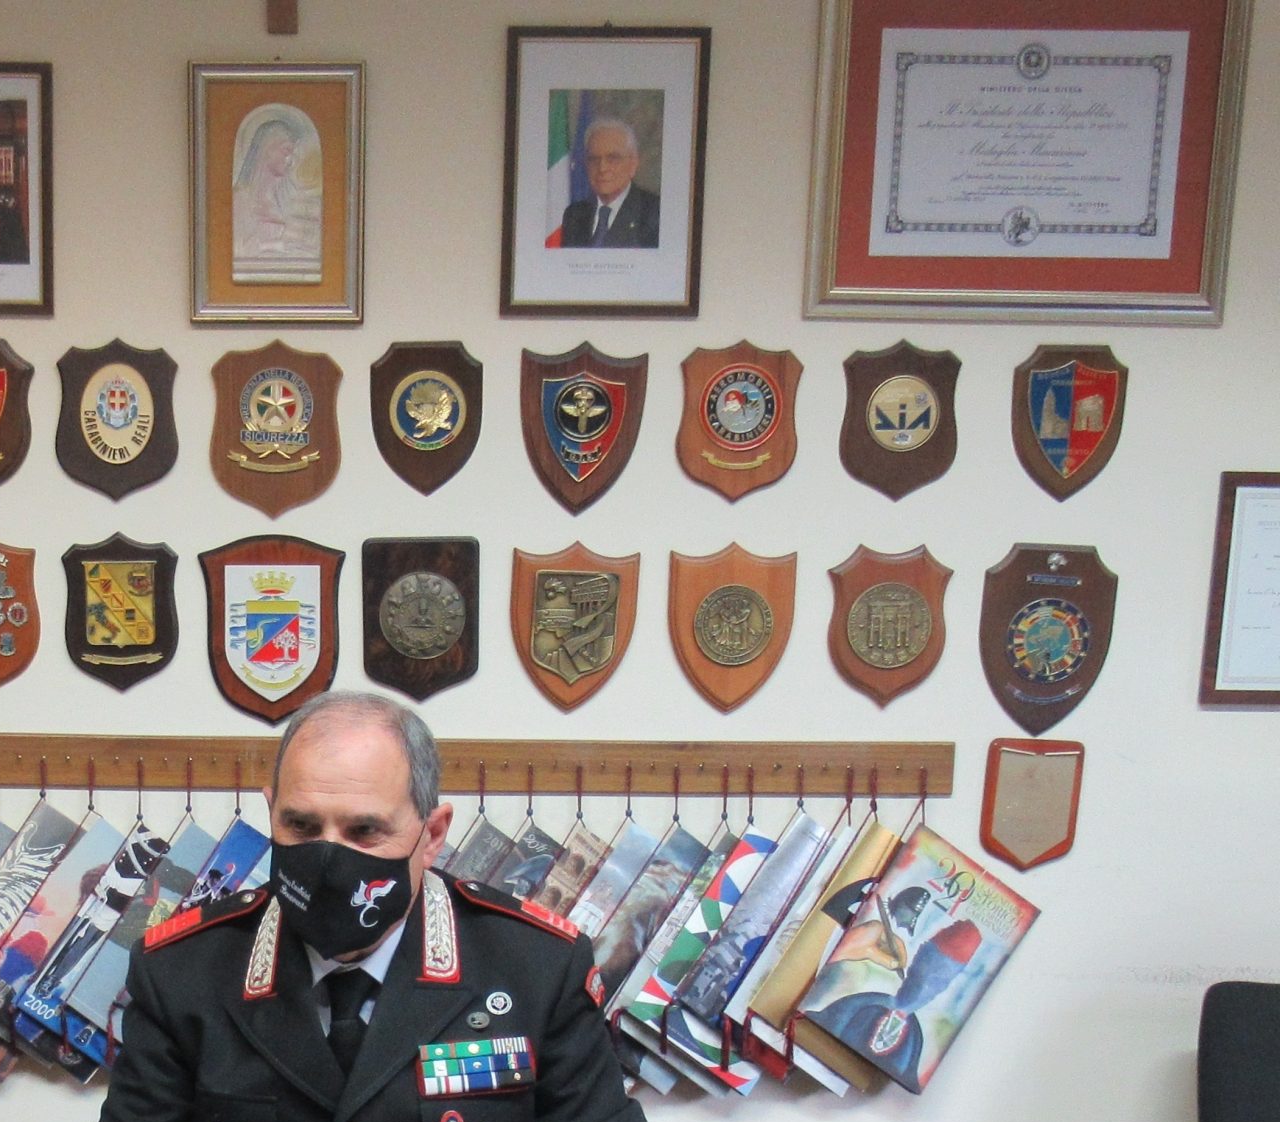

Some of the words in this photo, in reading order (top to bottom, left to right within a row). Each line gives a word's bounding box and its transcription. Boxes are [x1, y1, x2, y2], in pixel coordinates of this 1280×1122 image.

[83, 409, 131, 460] CARABINIERI
[131, 413, 151, 446] REALI
[244, 431, 306, 443] SICUREZZA
[22, 995, 56, 1021] 2000
